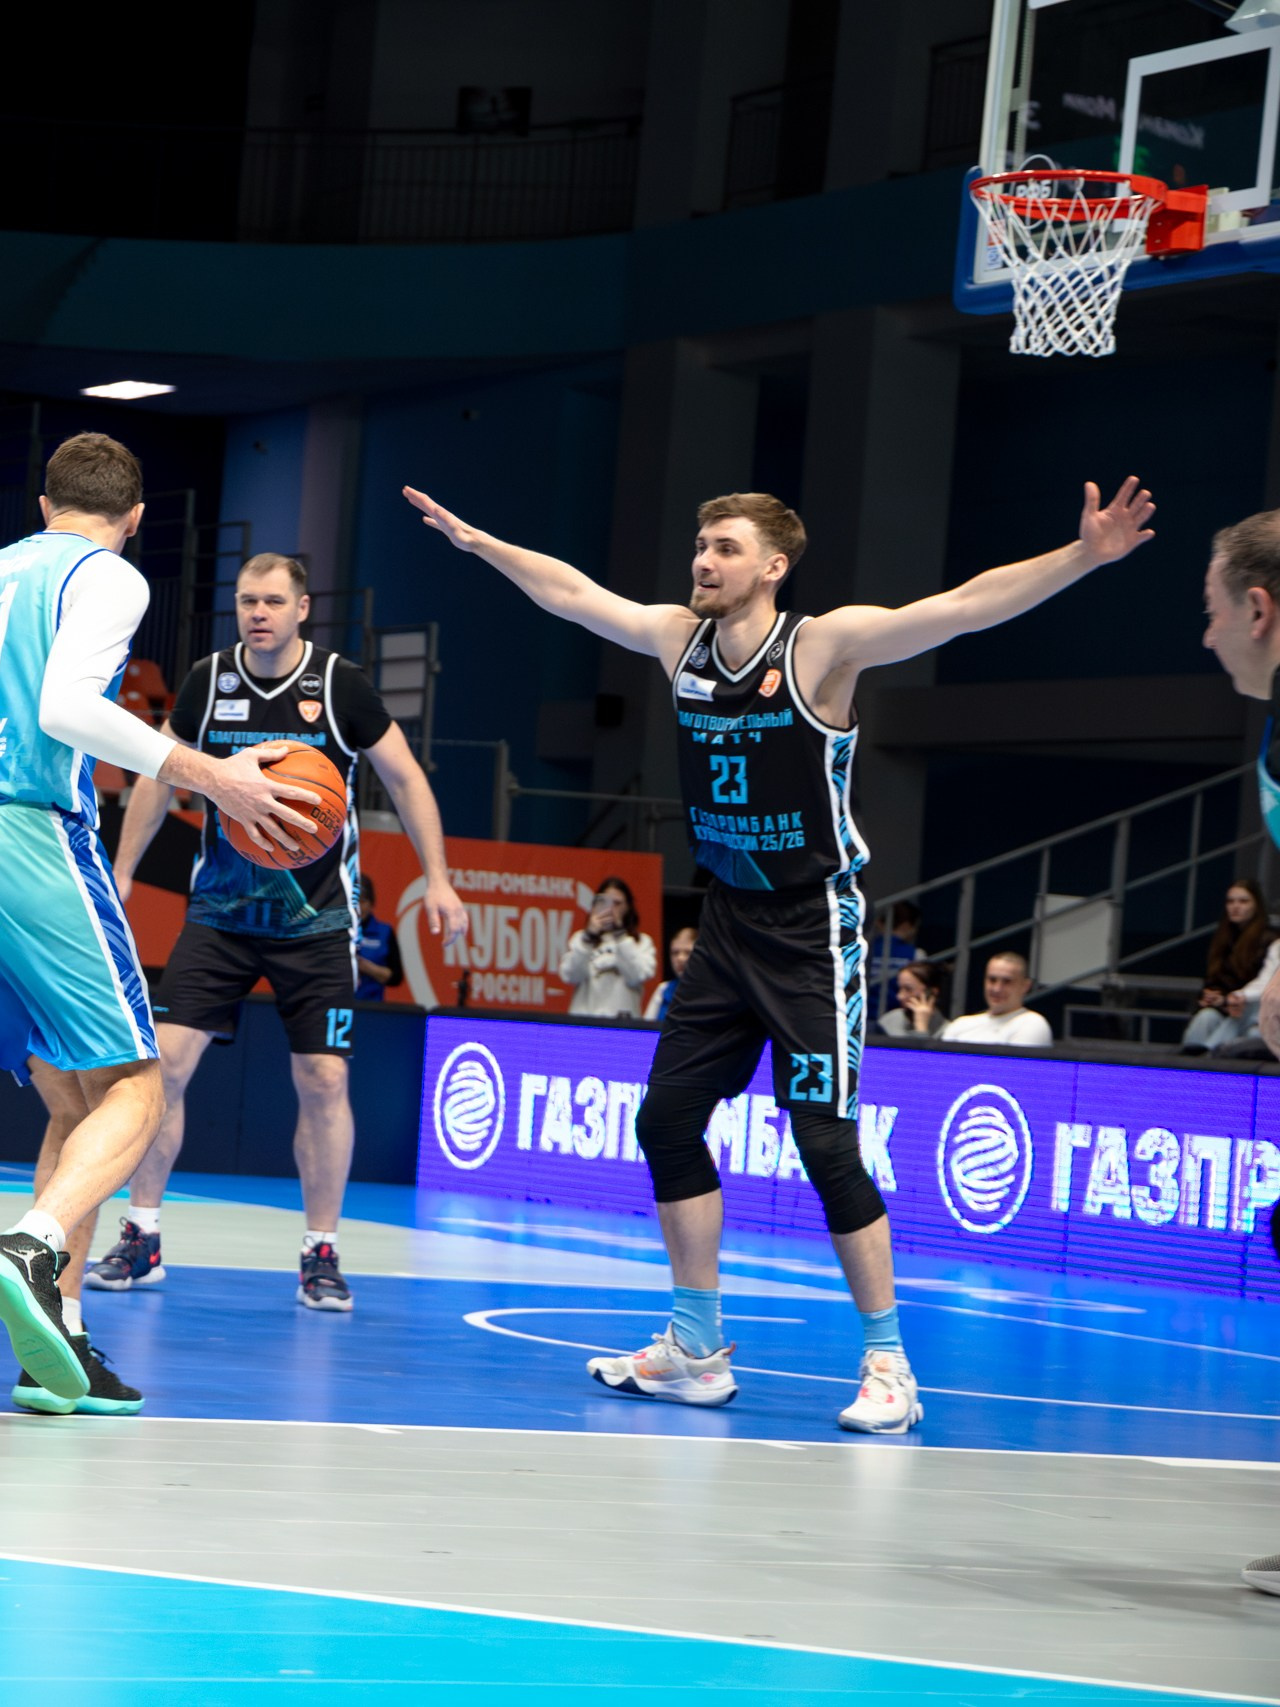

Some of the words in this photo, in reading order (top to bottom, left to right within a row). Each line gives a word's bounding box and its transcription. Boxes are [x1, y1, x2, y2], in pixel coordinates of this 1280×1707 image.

[692, 731, 762, 745] МАТЧ
[709, 755, 749, 804] 23
[760, 830, 805, 851] 25/26
[447, 867, 577, 898] ГАЗПРОМБАНК
[443, 902, 575, 974] КУБОК
[471, 971, 545, 1006] РОССИИ
[325, 1008, 354, 1048] 12
[789, 1053, 833, 1103] 23
[517, 1072, 898, 1191] ГАЗПМБК
[1051, 1121, 1280, 1234] ГАЗПР
